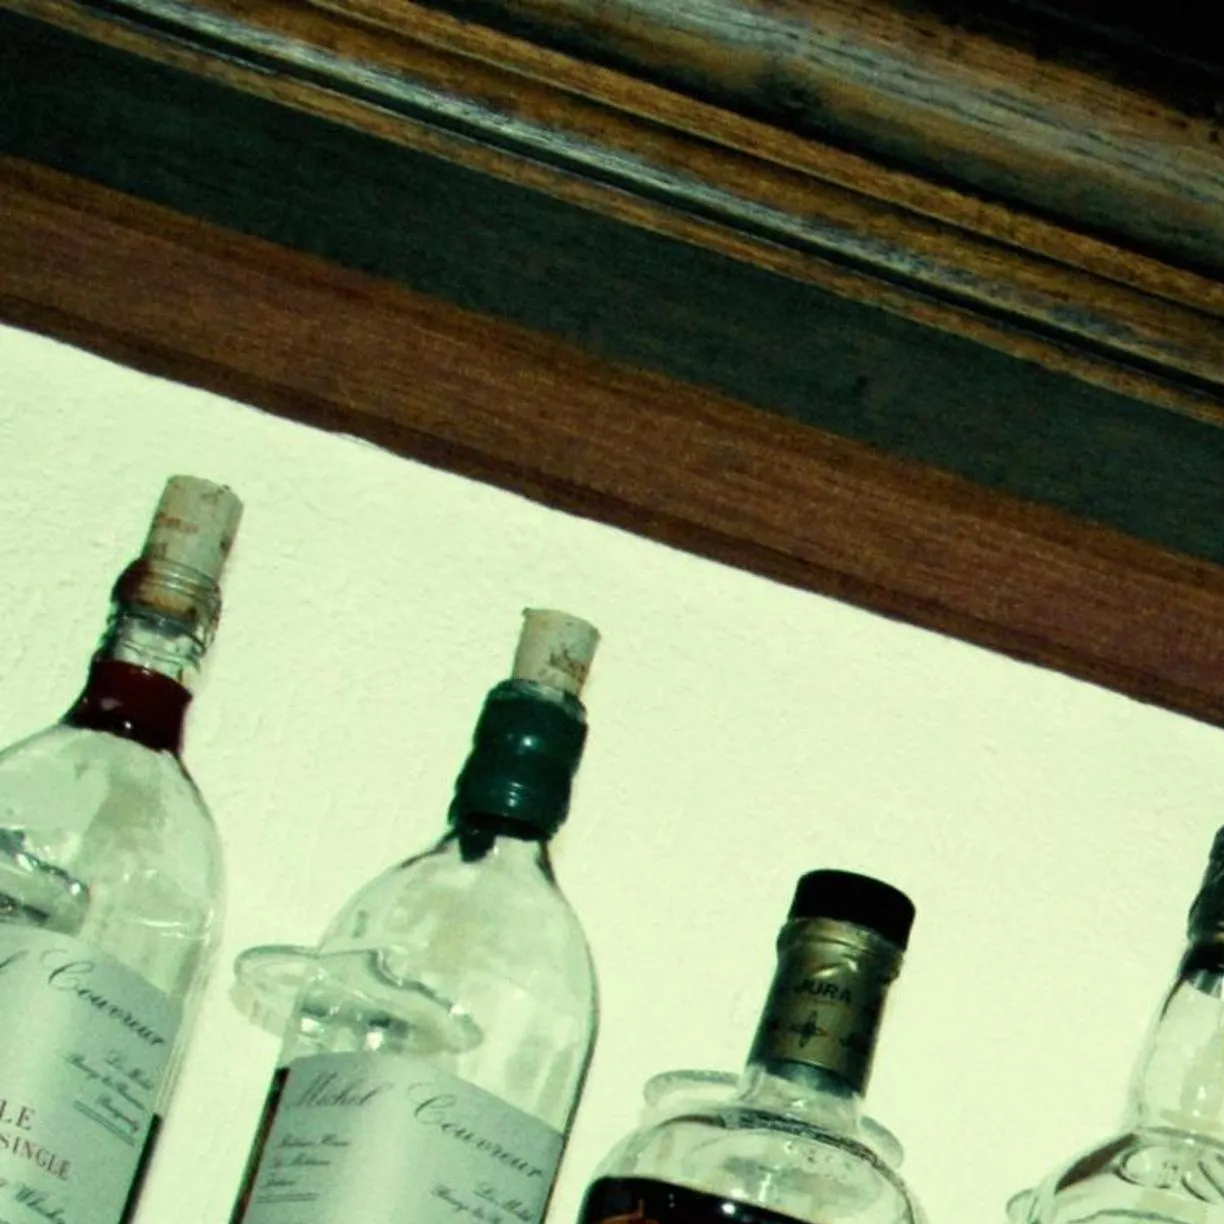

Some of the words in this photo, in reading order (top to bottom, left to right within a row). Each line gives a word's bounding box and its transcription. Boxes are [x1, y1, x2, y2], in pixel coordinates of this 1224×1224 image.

[40, 949, 165, 1046] Couvreur
[794, 979, 852, 1004] JURA
[408, 1082, 543, 1178] Couvreur
